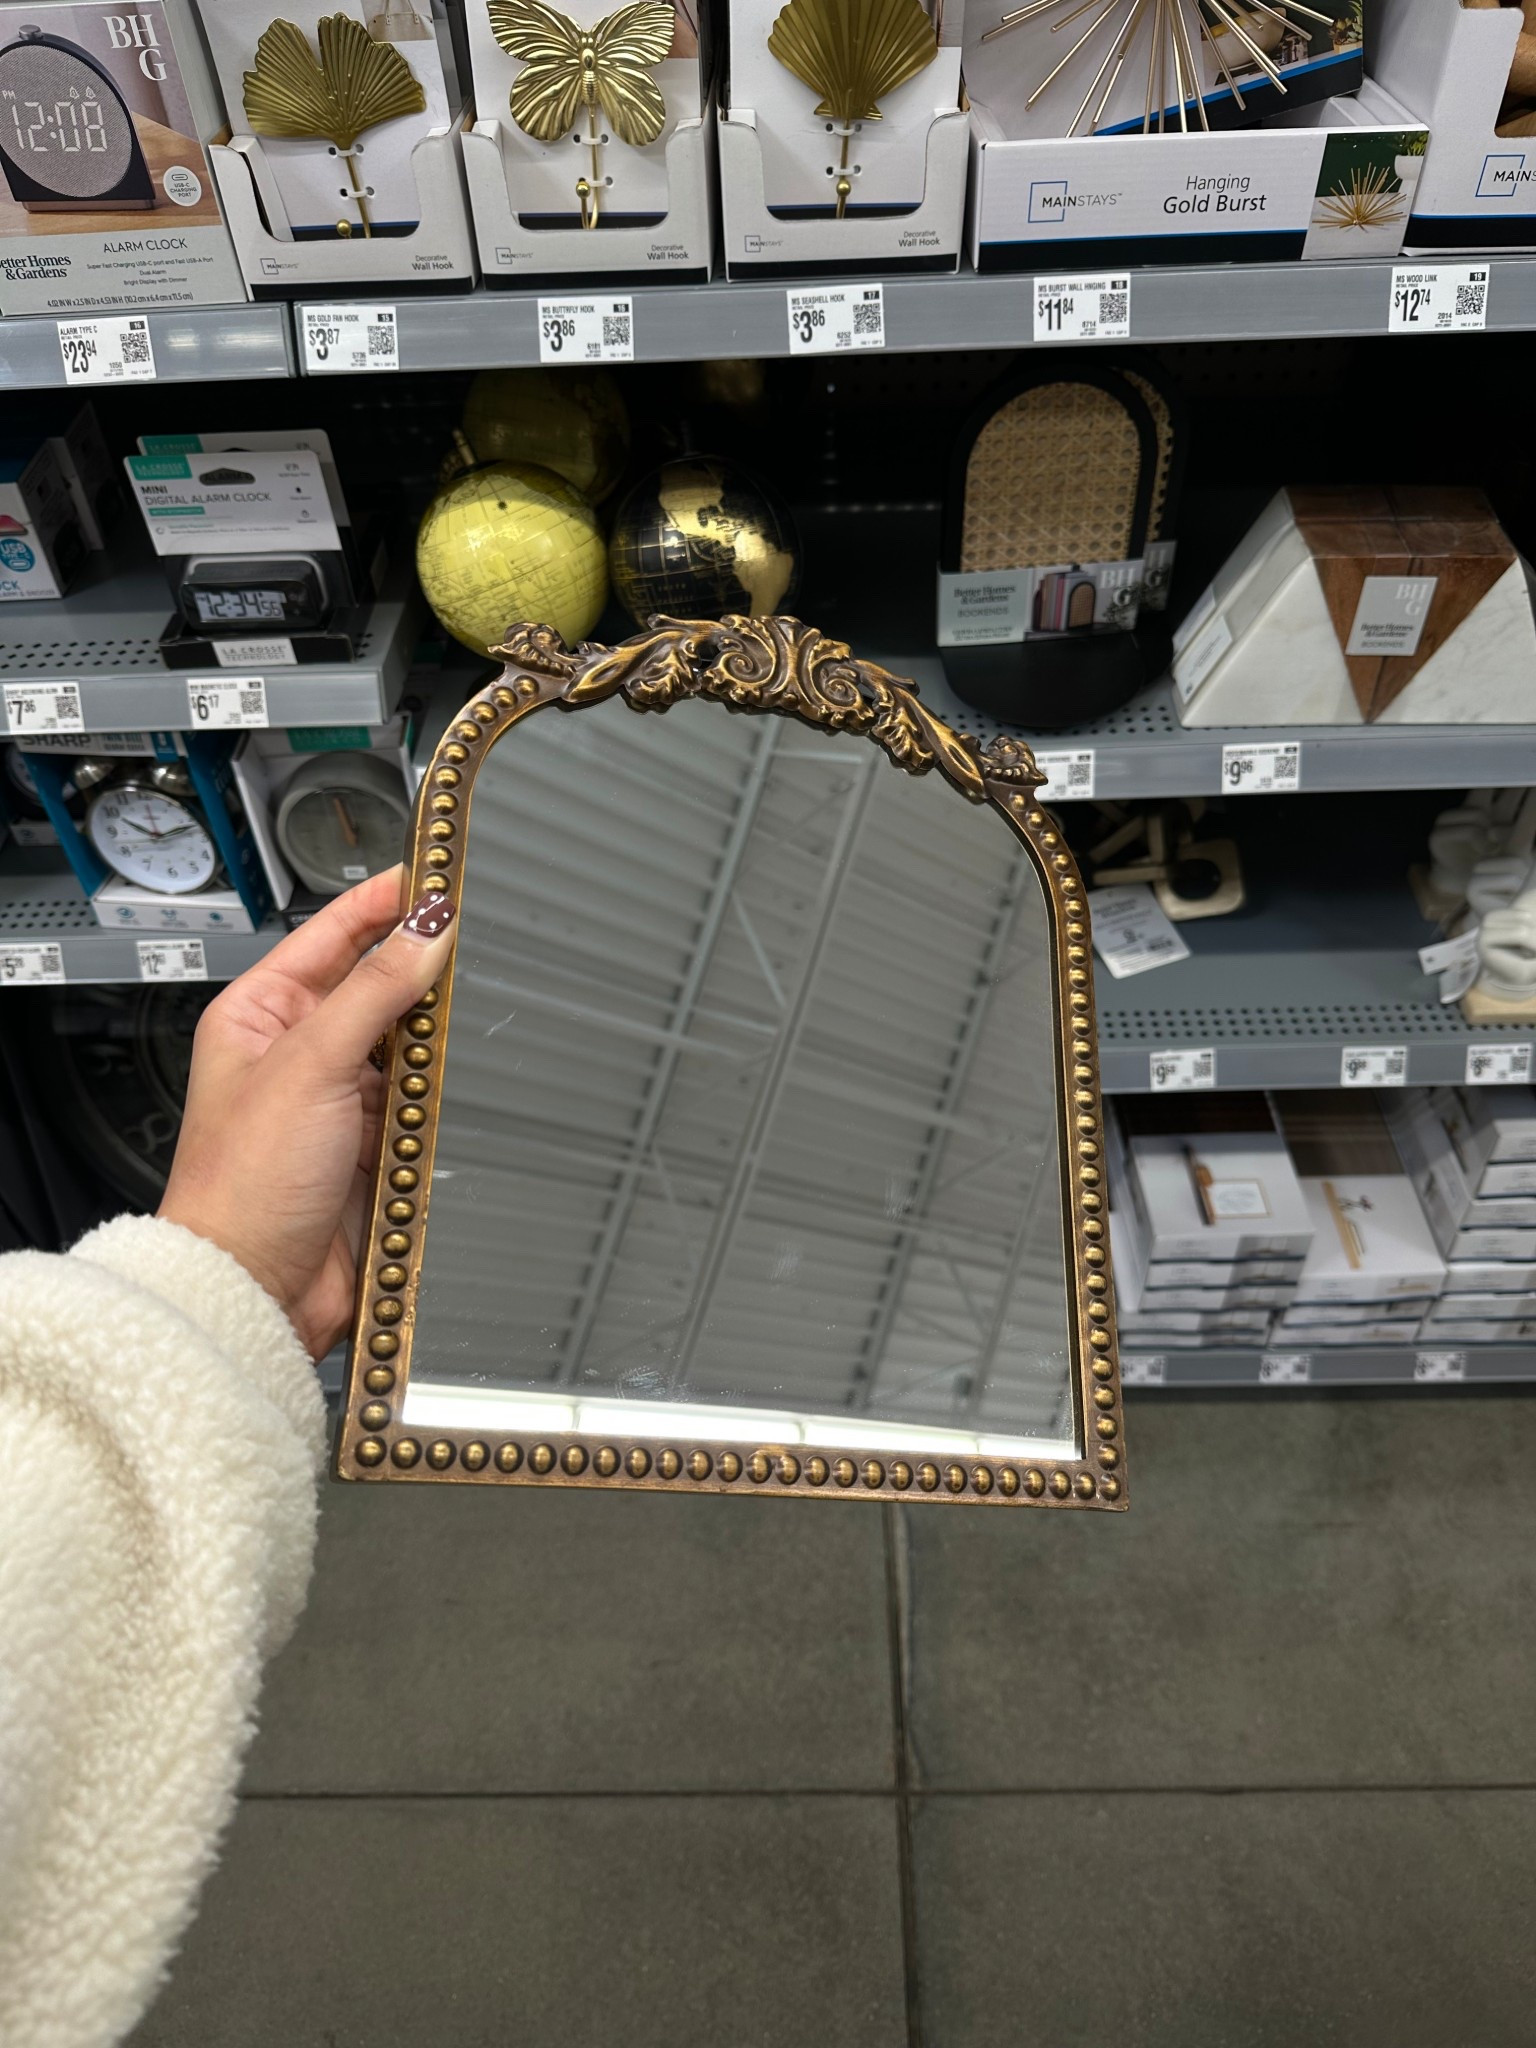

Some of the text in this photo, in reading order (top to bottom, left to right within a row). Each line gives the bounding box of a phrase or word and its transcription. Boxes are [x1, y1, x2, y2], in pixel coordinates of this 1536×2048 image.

[102, 14, 161, 49] BH
[138, 48, 168, 81] G
[2, 90, 17, 100] PM
[1186, 174, 1251, 194] Hanging
[1163, 194, 1267, 214] Gold Burst
[904, 230, 937, 239] Decorative
[103, 238, 188, 253] ALARM CLOCK
[650, 244, 684, 252] Decorative
[898, 237, 941, 248] Wall Hook
[415, 254, 448, 263] Decorative
[647, 251, 690, 261] Wall Hook
[0, 255, 72, 269] etter Homes
[412, 260, 454, 272] Wall Hook
[1396, 274, 1438, 283] MS WOOD LINK
[1038, 282, 1107, 293] MS BURST WALL HNGING
[791, 294, 846, 306] MS SEASHELL HOOK
[542, 306, 552, 314] MS
[579, 305, 595, 314] HOOK
[307, 314, 317, 323] MS
[317, 314, 332, 323] GOLD
[344, 313, 360, 322] HOOK
[60, 325, 99, 336] ALARM TYPE C
[140, 485, 168, 496] MINI
[144, 490, 273, 506] DIGITAL ALARM CLOCK
[222, 645, 285, 656] LA CROSSE
[106, 805, 121, 820] 10
[106, 825, 118, 839] 9
[120, 845, 132, 858] 8
[168, 866, 178, 879] 6
